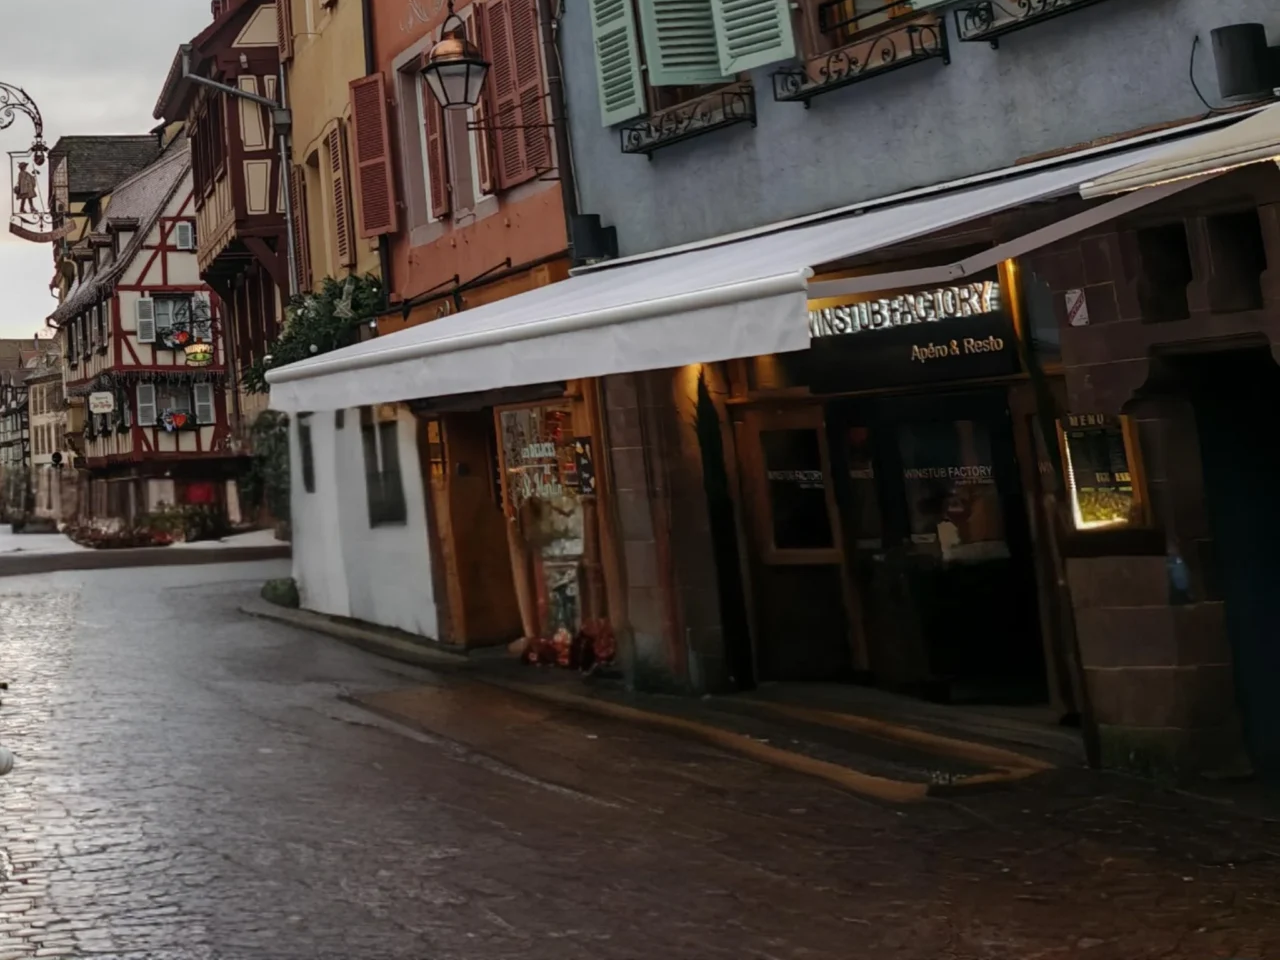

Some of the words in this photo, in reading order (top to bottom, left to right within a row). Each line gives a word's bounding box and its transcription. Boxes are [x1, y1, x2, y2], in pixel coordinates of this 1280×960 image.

[890, 280, 994, 327] FACTORY
[911, 342, 949, 363] Apéro
[950, 338, 960, 356] &
[963, 335, 1004, 353] Resto
[1069, 414, 1105, 426] MENU
[903, 467, 947, 478] WINSTUB
[948, 465, 992, 478] FACTORY
